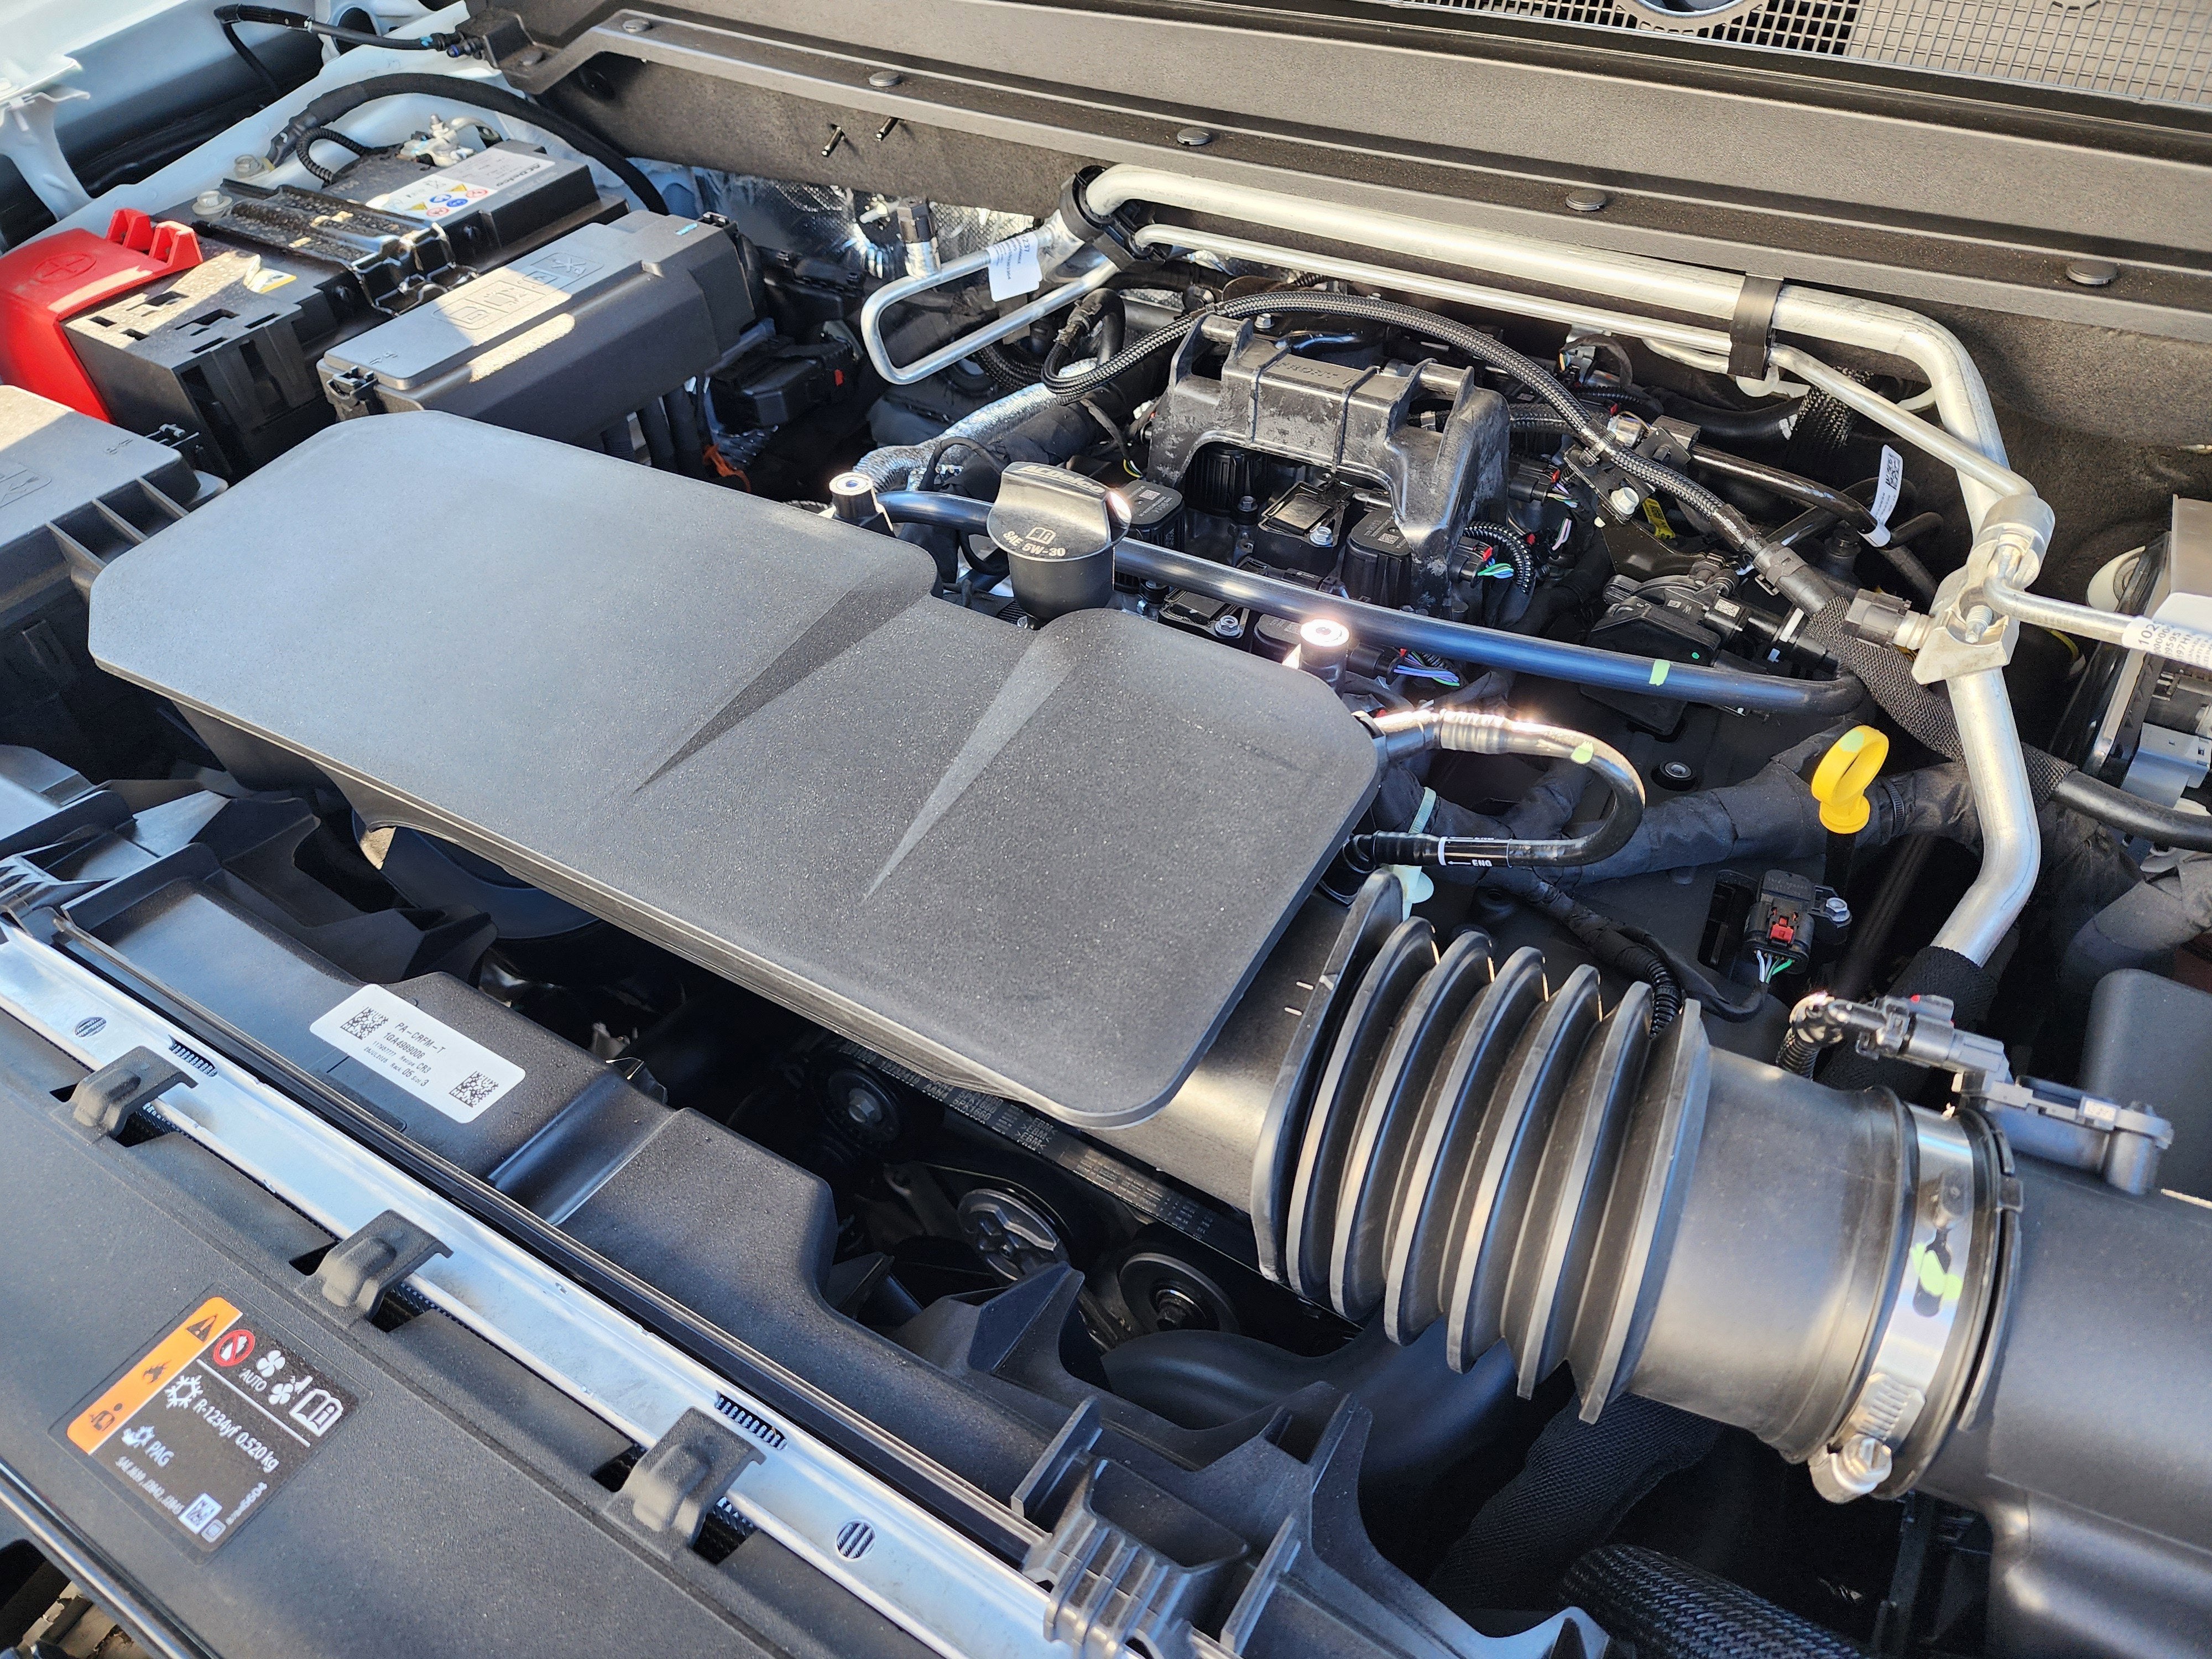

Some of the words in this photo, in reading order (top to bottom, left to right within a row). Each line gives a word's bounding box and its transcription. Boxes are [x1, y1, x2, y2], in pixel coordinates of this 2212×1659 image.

[1017, 465, 1105, 494] ACDelco
[1003, 531, 1023, 546] SAE
[1022, 543, 1066, 556] 5W-30
[395, 1022, 446, 1054] PA-CRFM-T
[401, 1068, 415, 1077] 05
[416, 1063, 432, 1074] CR3
[239, 1369, 268, 1392] AUTO
[115, 1456, 134, 1473] SAE
[144, 1440, 175, 1467] PAG
[260, 1451, 279, 1474] kg
